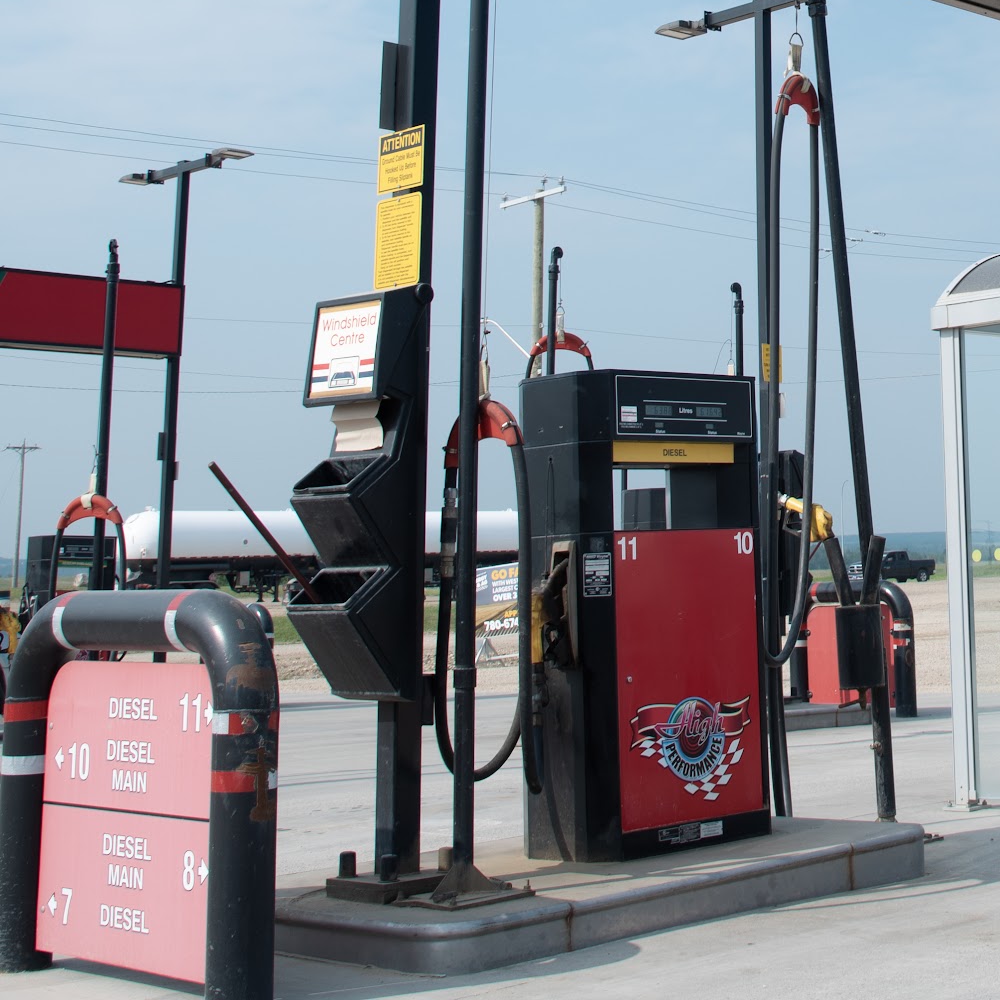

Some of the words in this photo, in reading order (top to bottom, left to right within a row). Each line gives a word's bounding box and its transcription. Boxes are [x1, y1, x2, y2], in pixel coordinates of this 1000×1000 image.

[382, 131, 421, 153] ATTENTION
[322, 312, 377, 332] Windshield
[330, 332, 365, 347] Centre
[663, 449, 687, 457] DIESEL
[617, 536, 637, 560] 11
[733, 531, 753, 554] 10
[491, 569, 507, 580] GO
[492, 585, 513, 594] LARGEST
[493, 592, 512, 602] OVER
[108, 696, 157, 721] DIESEL
[179, 692, 202, 732] 11
[654, 700, 725, 746] High
[68, 742, 90, 781] 10
[106, 739, 155, 764] DIESEL
[665, 736, 723, 778] PERFORMANCE
[112, 769, 147, 793] MAIN
[102, 833, 151, 861] DIESEL
[107, 863, 143, 890] MAIN
[182, 850, 195, 891] 8
[61, 887, 73, 925] 7
[100, 904, 149, 934] DIESEL
